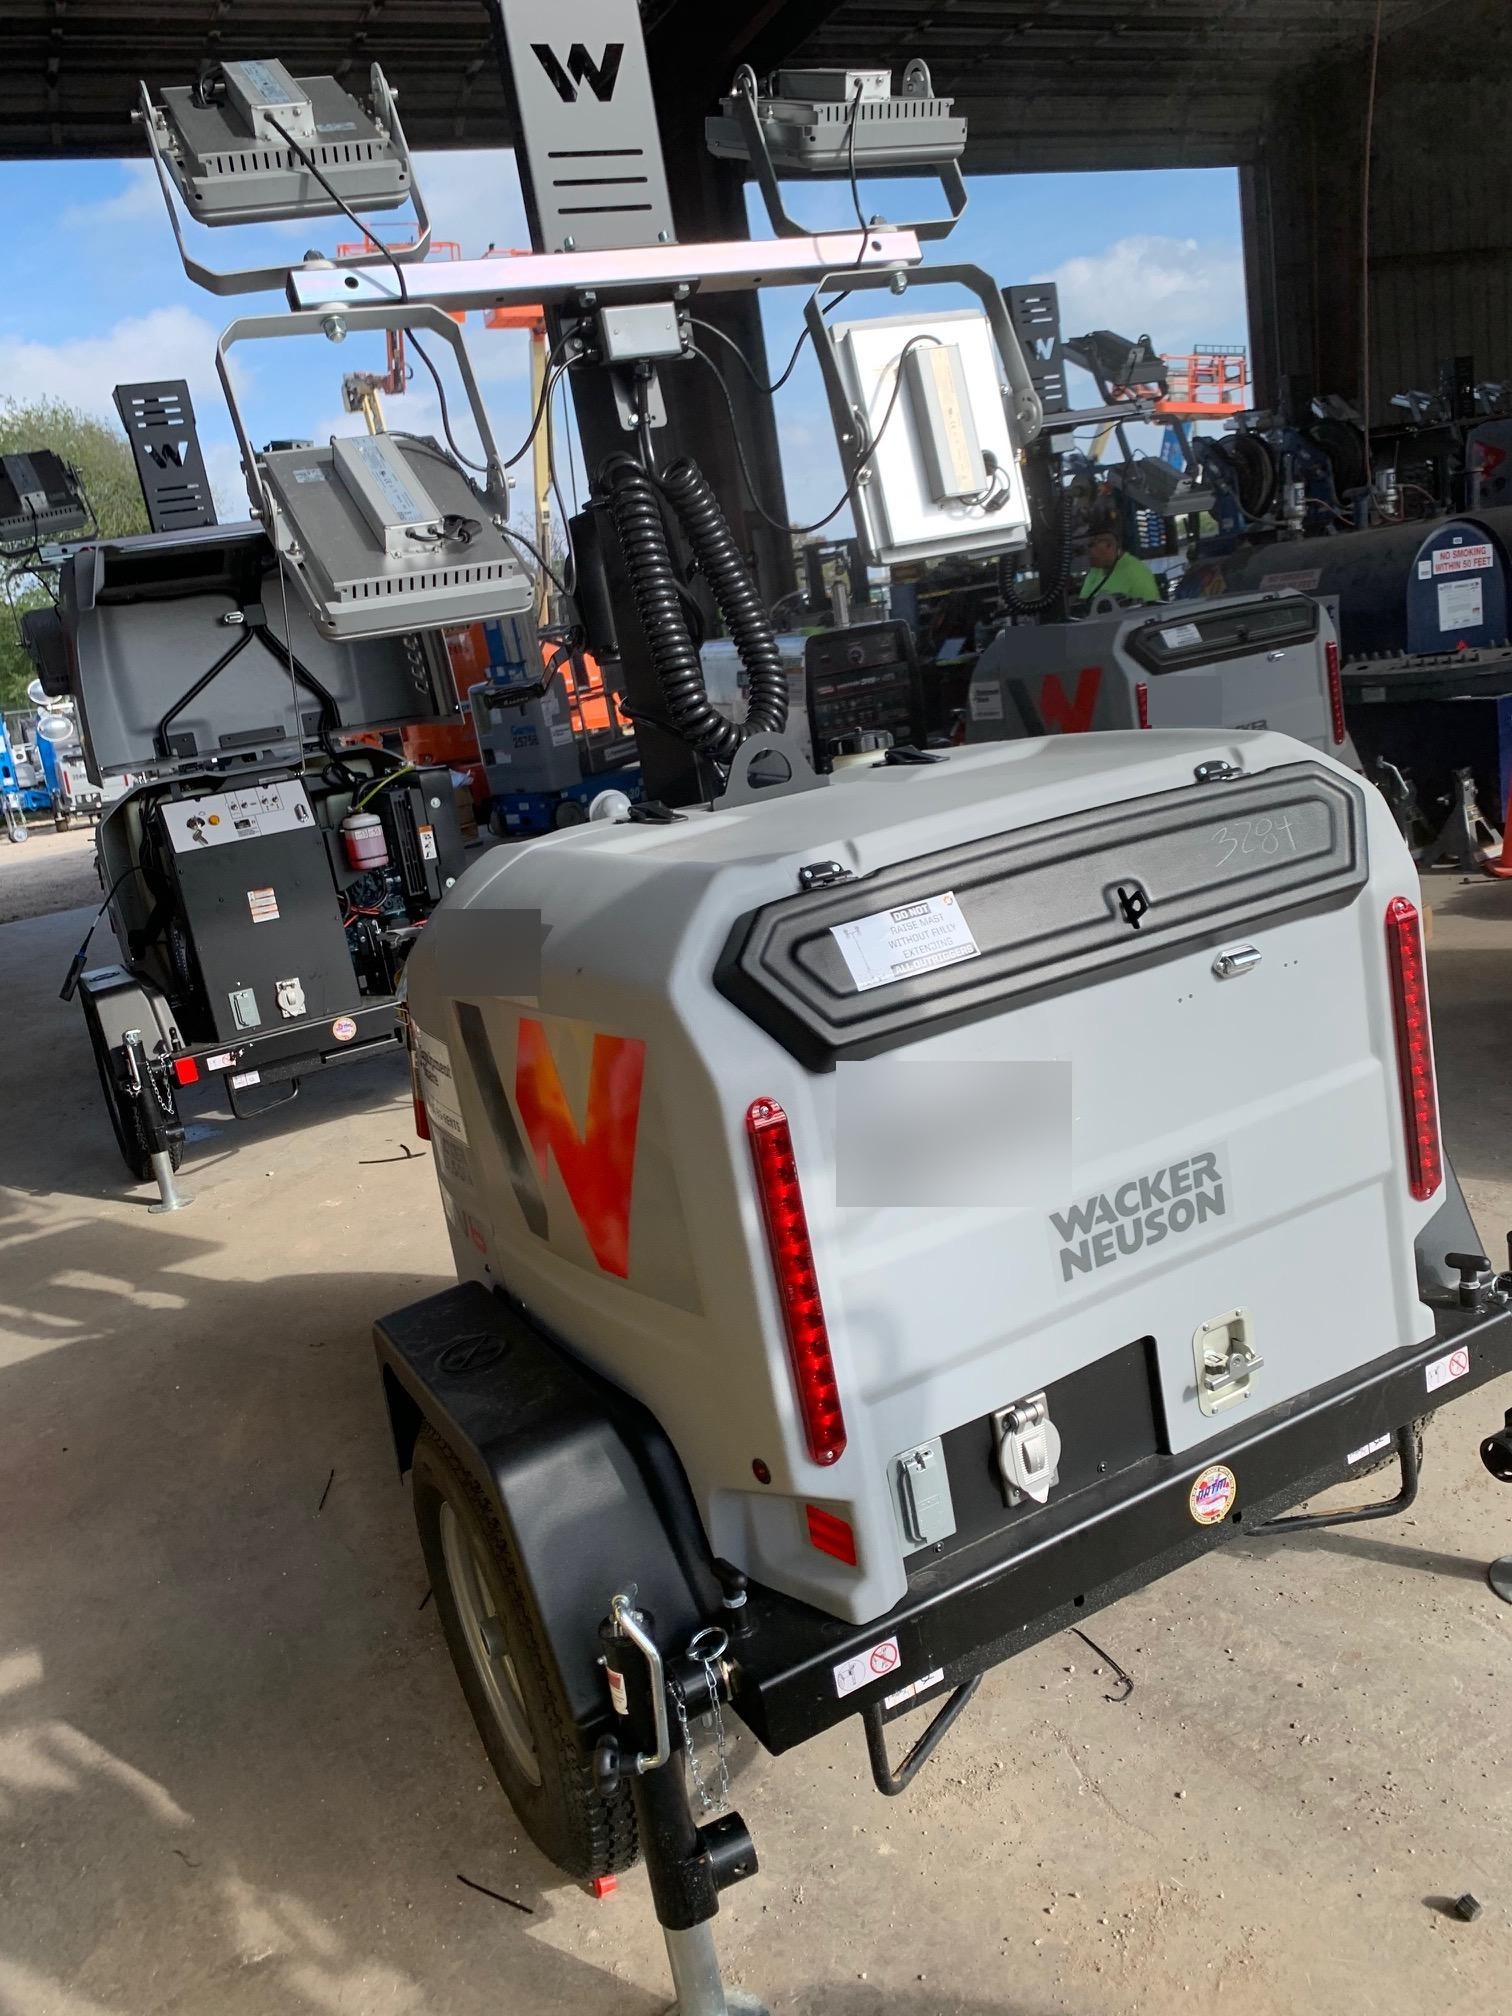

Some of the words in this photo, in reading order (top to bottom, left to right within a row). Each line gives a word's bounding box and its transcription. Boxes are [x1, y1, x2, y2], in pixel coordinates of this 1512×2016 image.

[530, 43, 624, 103] W
[1435, 561, 1461, 572] WITHIN
[1463, 559, 1472, 568] 50
[1473, 556, 1492, 567] FEET
[1440, 551, 1450, 560] NO
[1452, 546, 1487, 559] SMOKING
[889, 918, 918, 936] RAISE
[919, 912, 945, 929] MAST
[893, 911, 909, 922] DO
[910, 904, 930, 917] NOT
[888, 932, 930, 950] WITHOUT
[931, 923, 957, 938] FULLY
[903, 937, 954, 959] EXTENDING
[894, 962, 913, 975] ALL
[913, 944, 975, 968] OUTRIGGERS
[1049, 1152, 1223, 1243] WACKER
[1059, 1183, 1226, 1283] NEUSON
